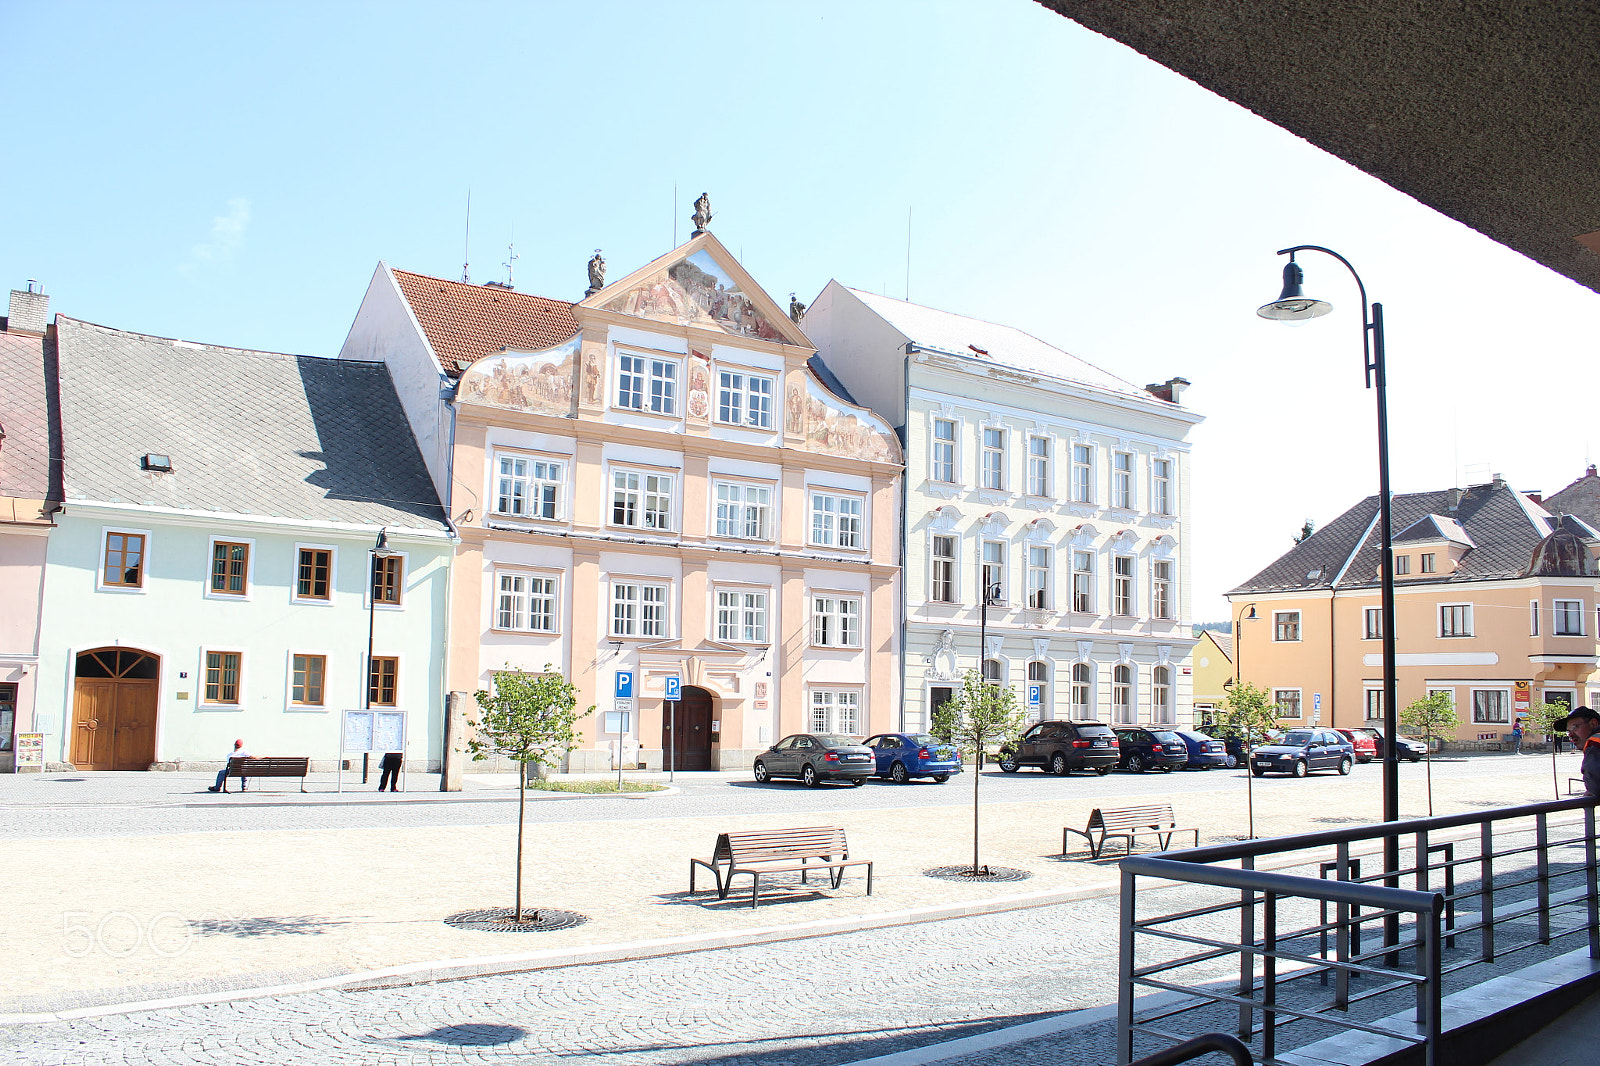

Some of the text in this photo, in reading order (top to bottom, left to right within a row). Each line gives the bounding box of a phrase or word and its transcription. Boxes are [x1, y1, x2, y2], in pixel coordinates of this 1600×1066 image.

[619, 674, 630, 690] P
[669, 679, 677, 693] P
[1030, 688, 1038, 700] P
